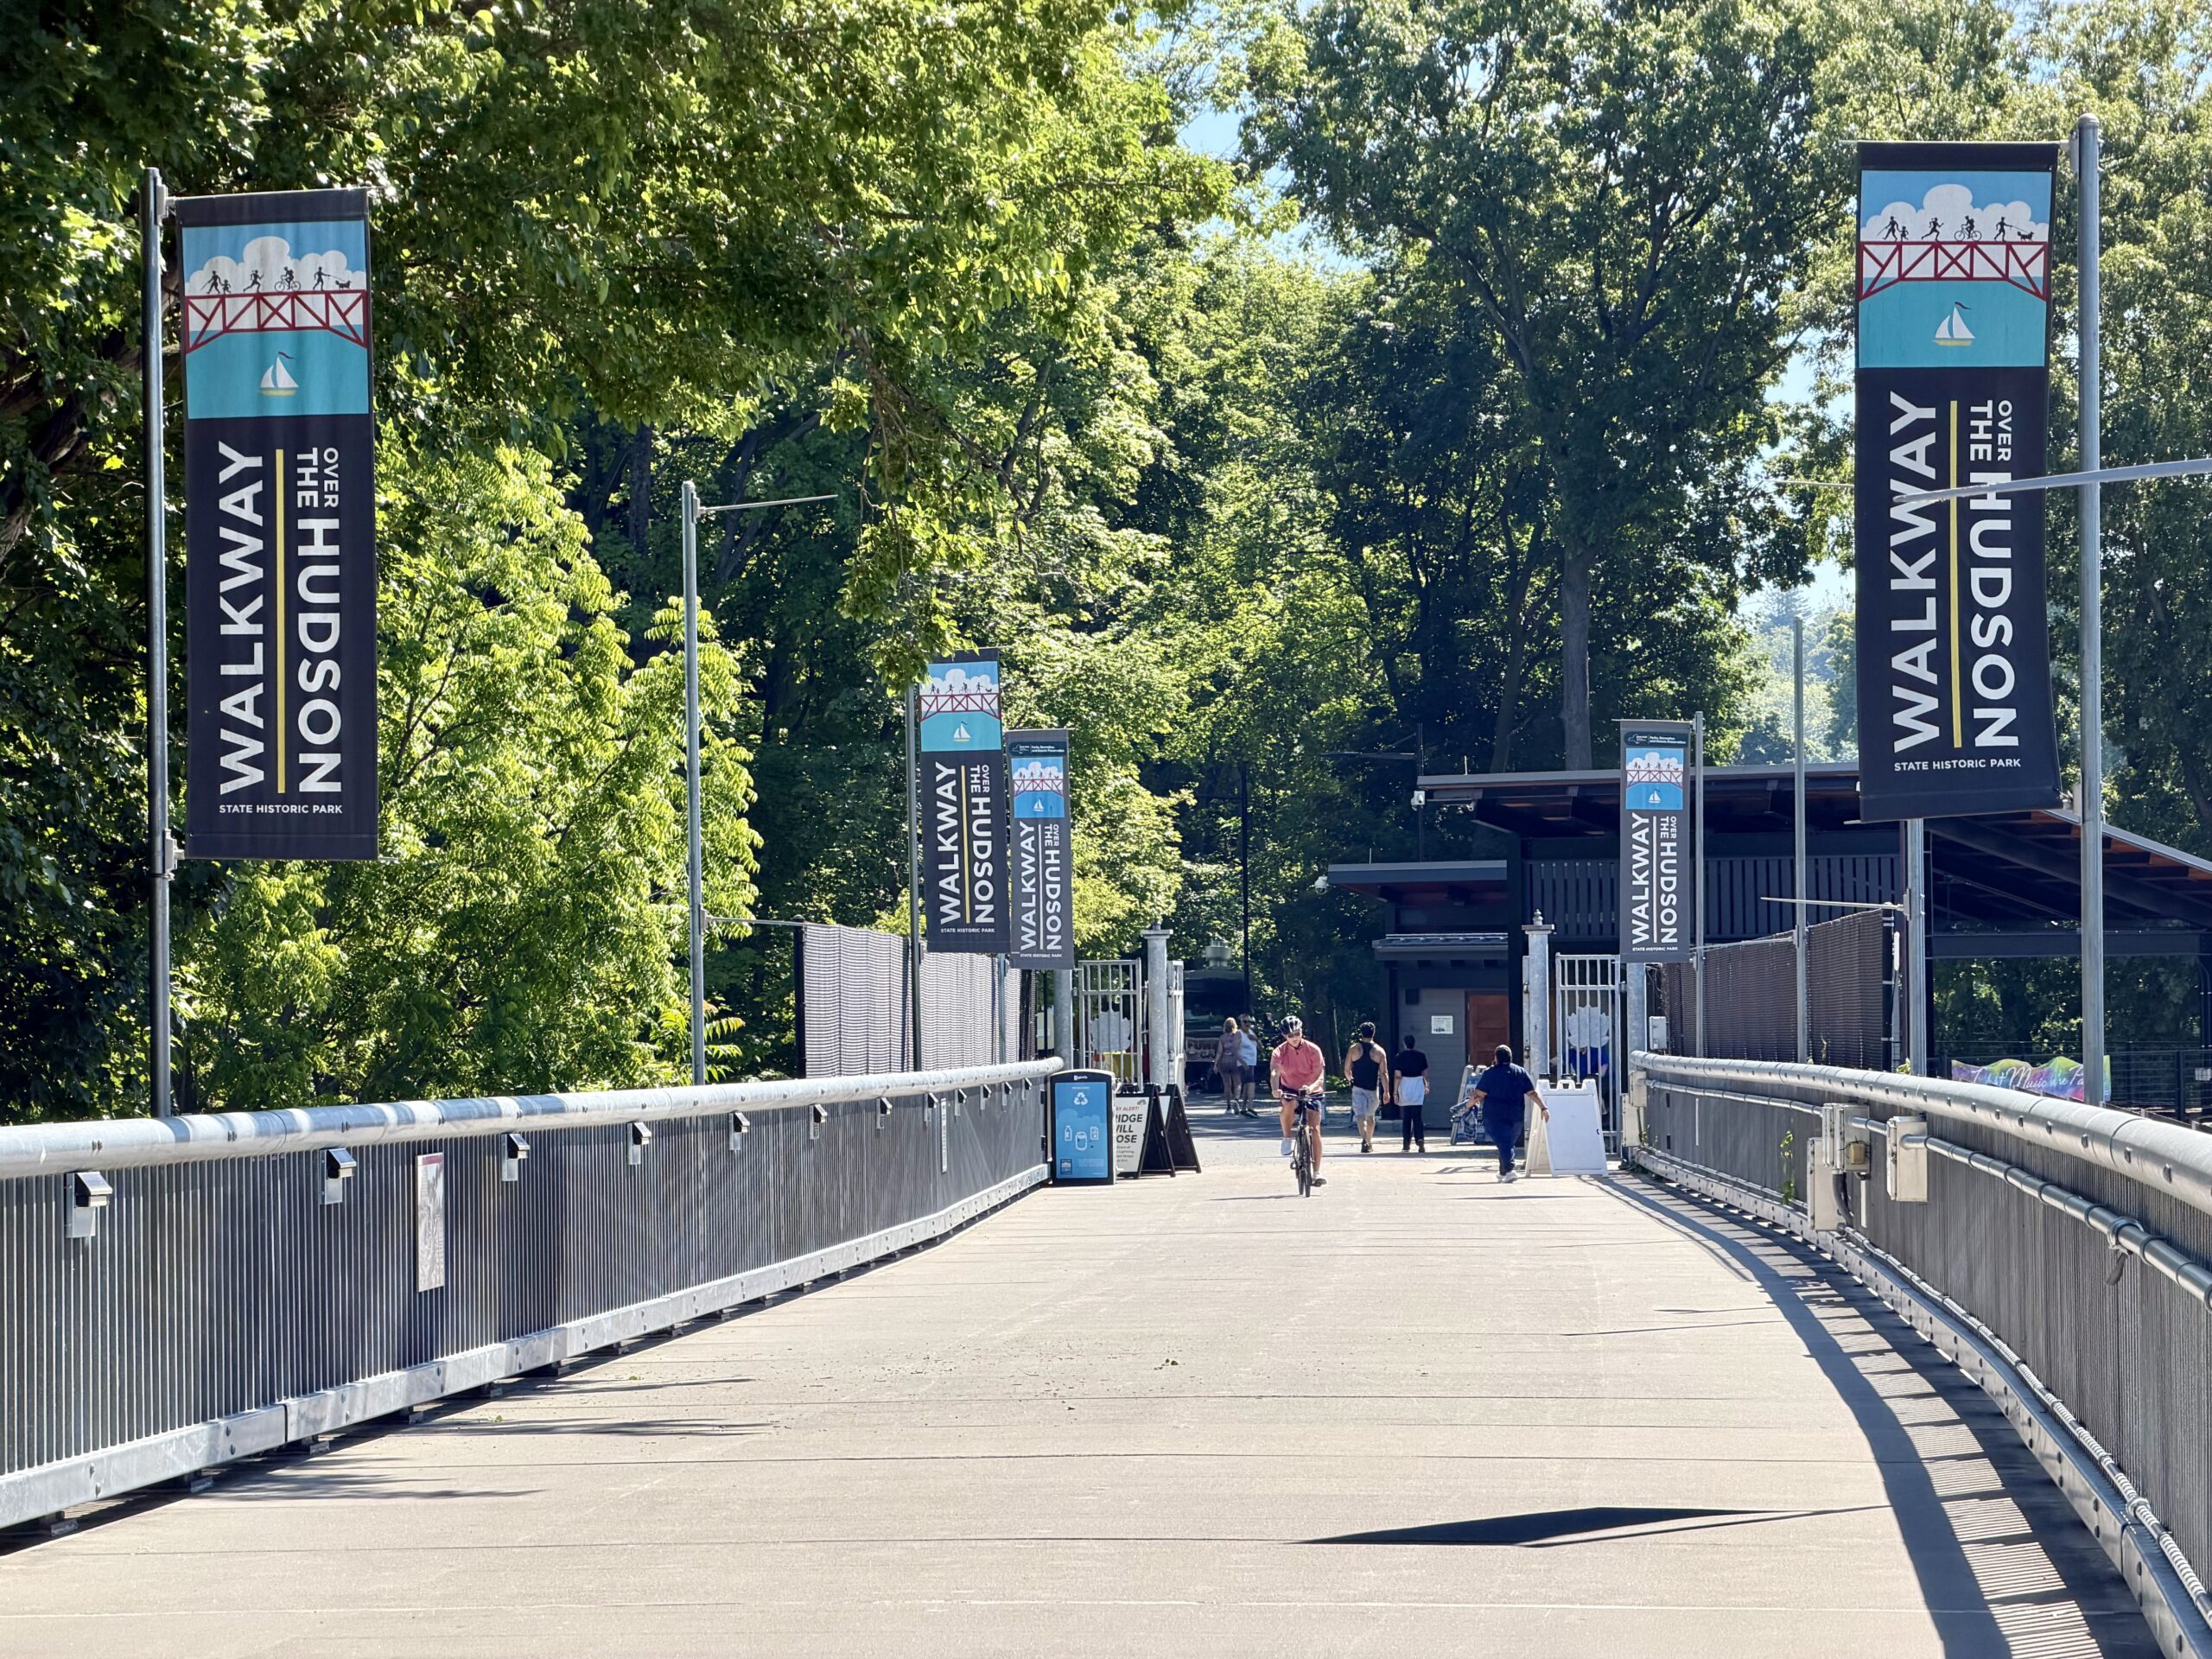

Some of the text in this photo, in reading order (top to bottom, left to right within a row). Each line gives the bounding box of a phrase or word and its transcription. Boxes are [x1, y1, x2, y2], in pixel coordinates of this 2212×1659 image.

[323, 447, 339, 508] OVER
[1997, 399, 2012, 461] OVER
[218, 441, 264, 796] WALKWAY
[296, 447, 342, 792] THE HUDSON
[1890, 391, 1940, 753] WALKWAY
[1969, 399, 2019, 747] THE HUDSON
[219, 804, 343, 814] STATE HISTORIC PARK
[980, 764, 990, 793] OVER
[1894, 758, 2021, 772] STATE HISTORIC PARK
[935, 761, 961, 925] WALKWAY
[969, 764, 995, 924] THE HUDSON
[1019, 821, 1037, 950] WALKWAY
[1044, 823, 1062, 950] THE HUDSON
[1631, 812, 1649, 944] WALKWAY
[1660, 816, 1678, 944] THE HUDSON
[1116, 1135, 1137, 1143] OSE
